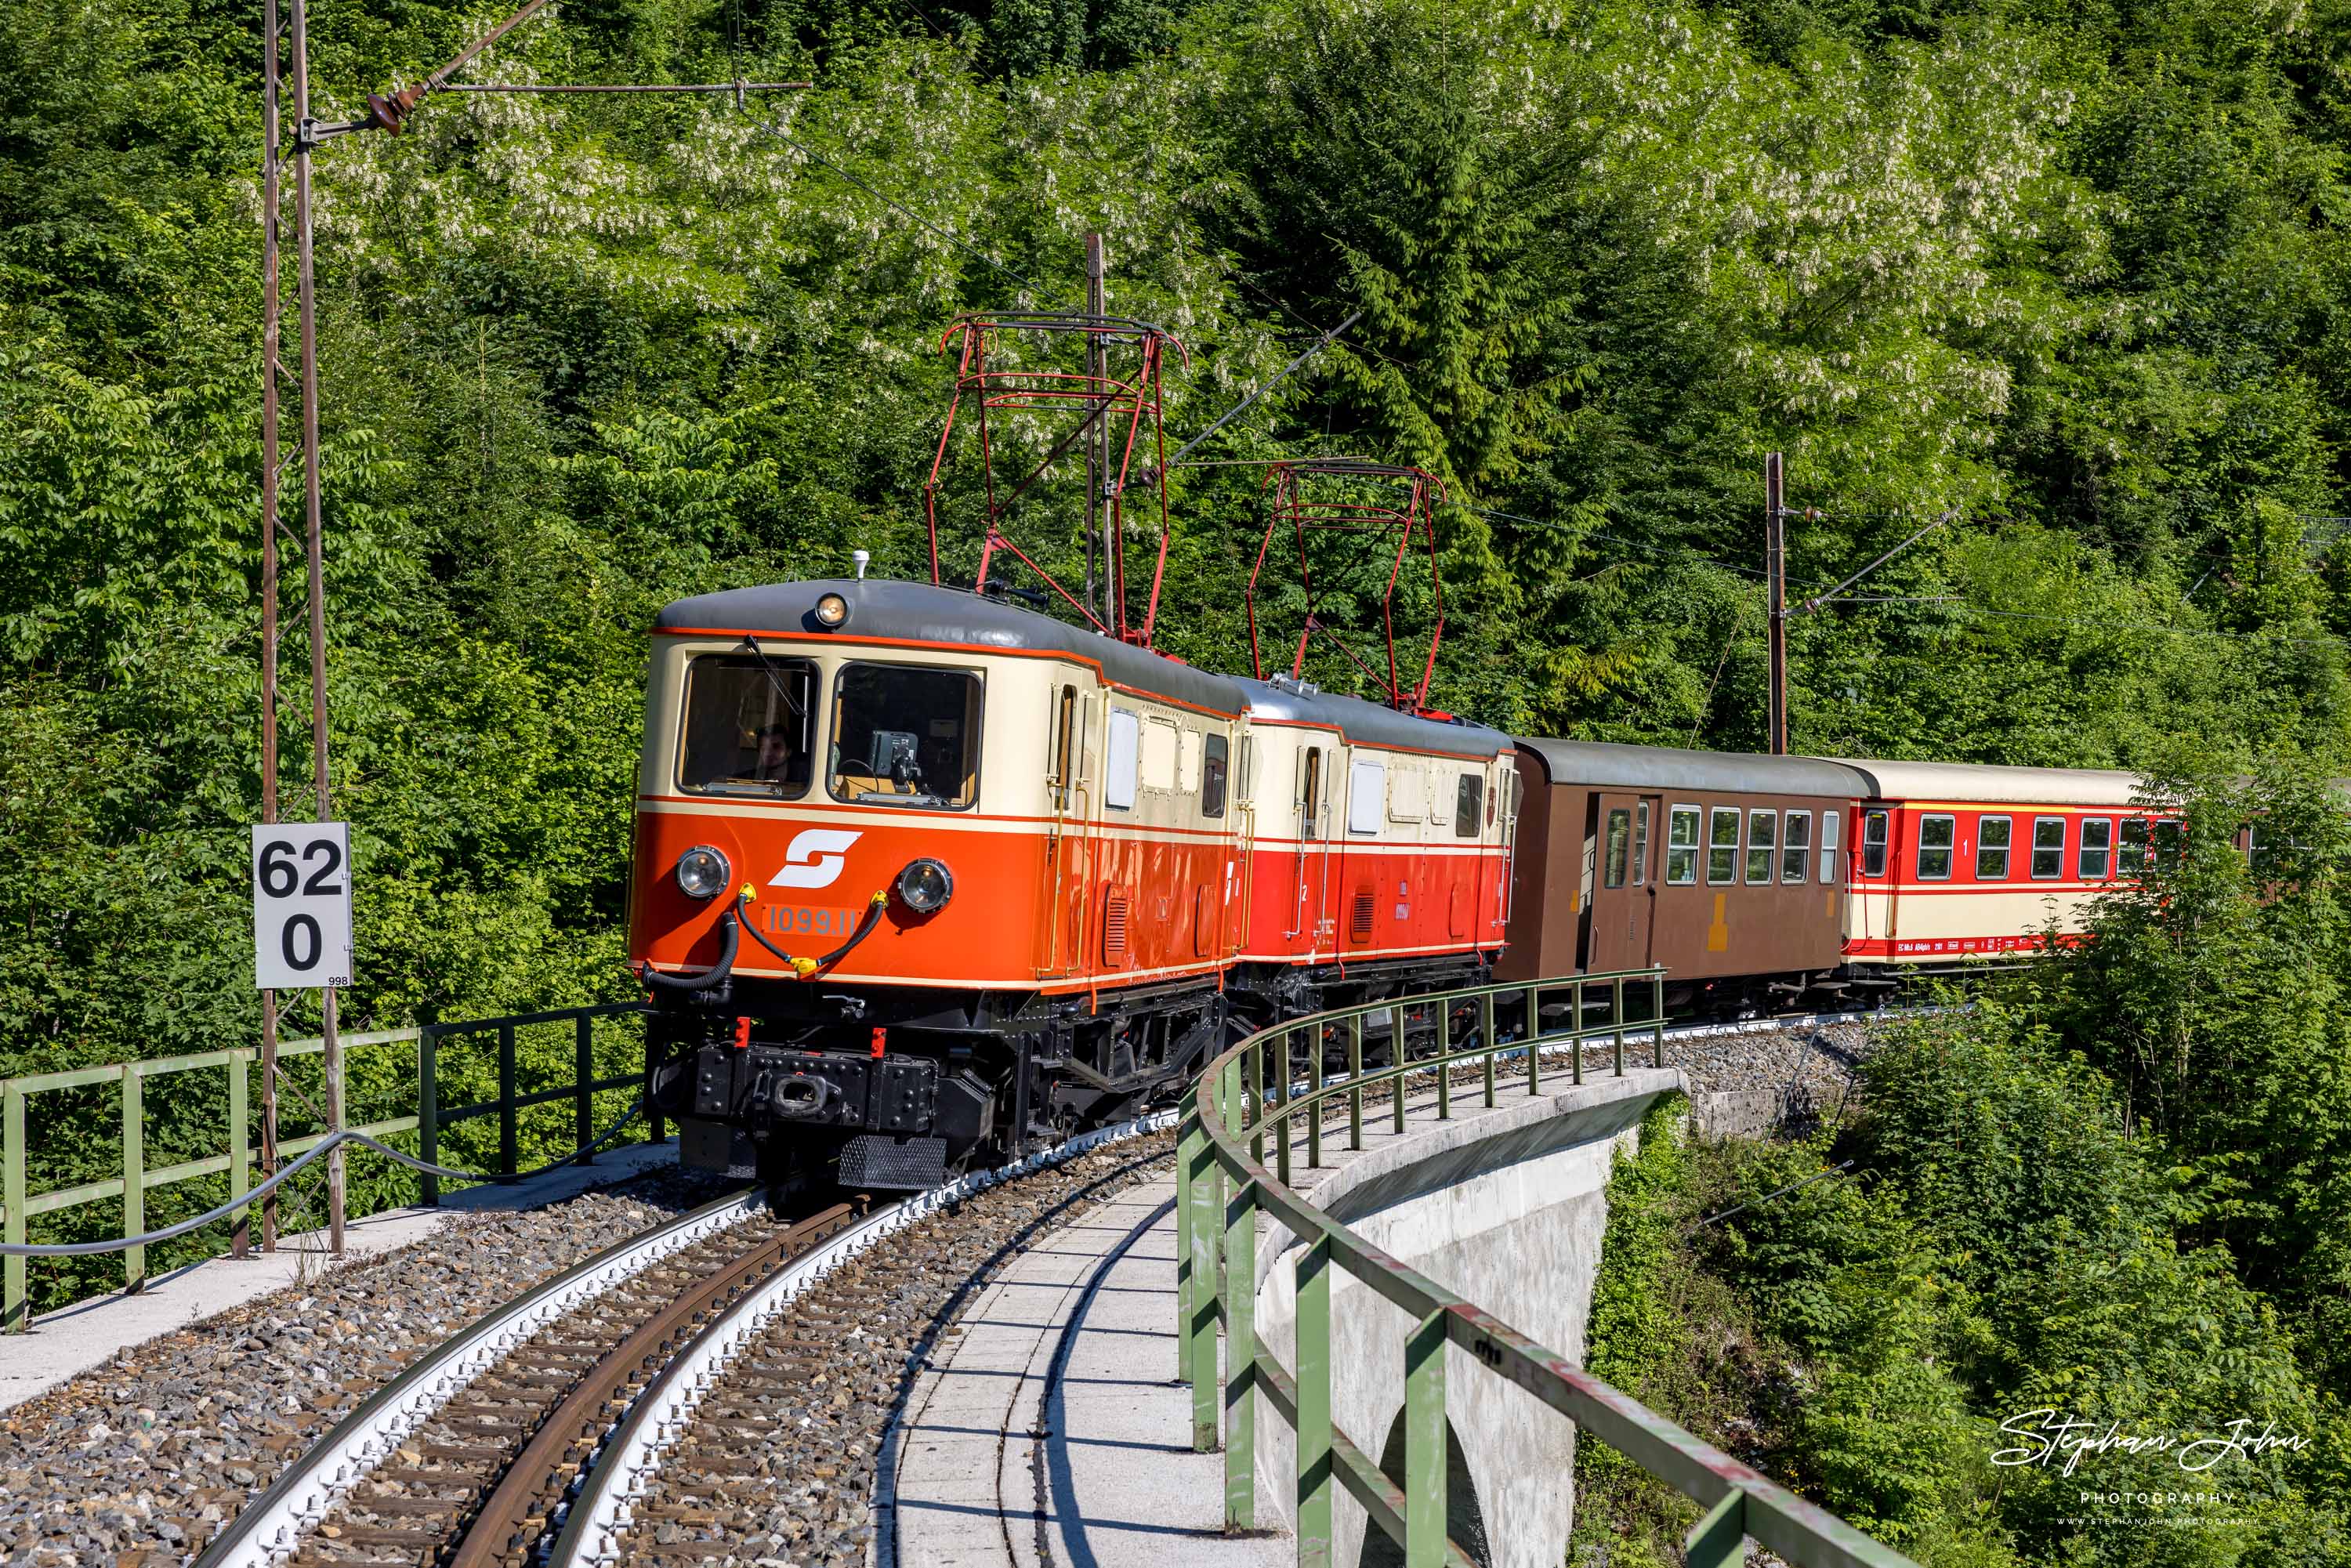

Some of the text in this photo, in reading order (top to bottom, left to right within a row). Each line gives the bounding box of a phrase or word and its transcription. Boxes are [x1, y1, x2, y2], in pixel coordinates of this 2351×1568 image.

[1963, 839, 1968, 856] 1
[259, 839, 342, 898] 62
[1302, 884, 1308, 902] 2
[770, 906, 855, 936] 1099.11
[282, 913, 322, 971] 0
[328, 977, 348, 986] 998
